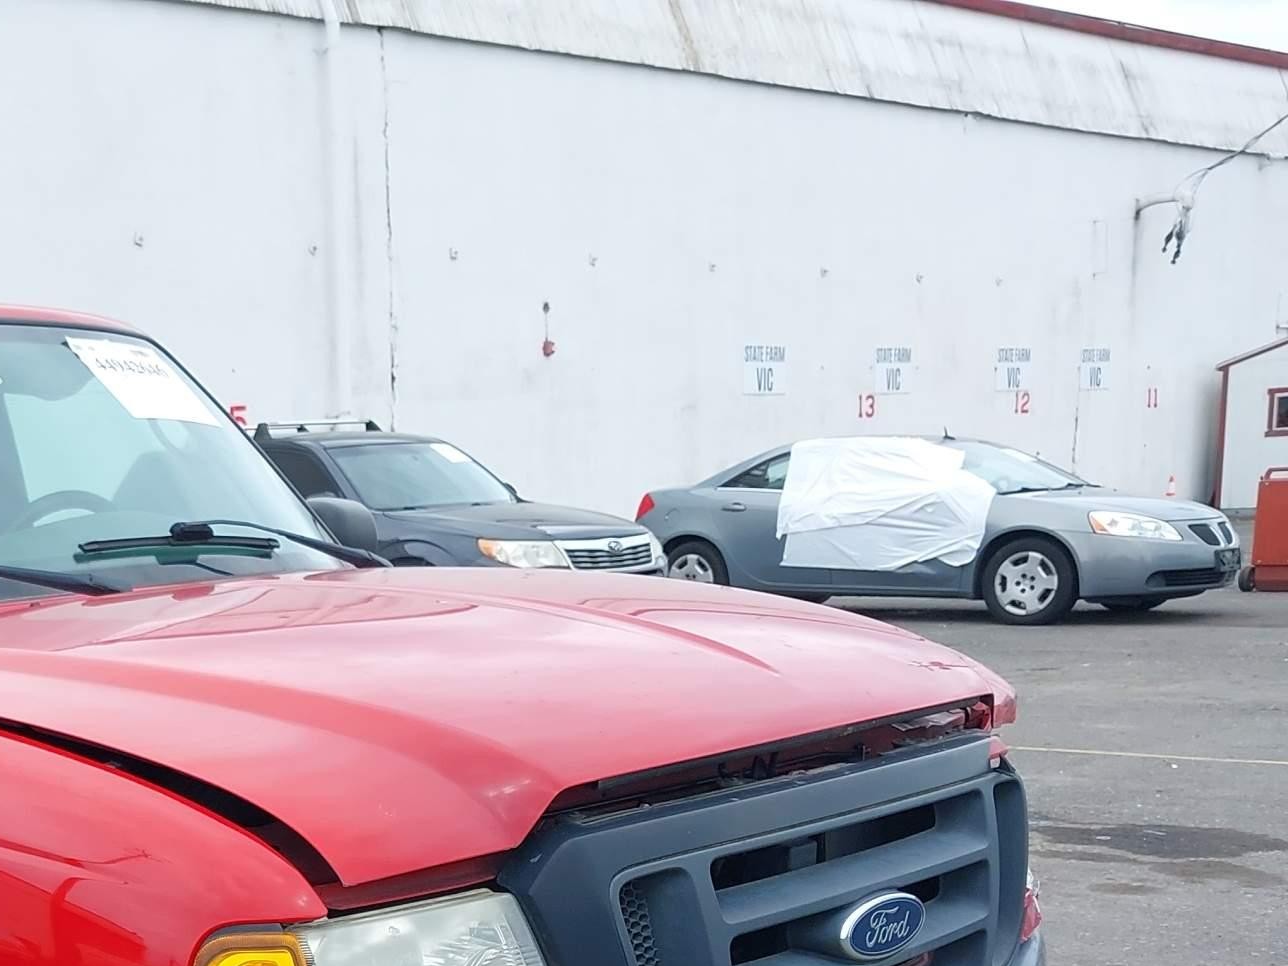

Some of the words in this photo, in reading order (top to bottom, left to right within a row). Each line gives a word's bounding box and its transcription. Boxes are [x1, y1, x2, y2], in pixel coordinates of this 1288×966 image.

[744, 345, 764, 362] STATE
[765, 345, 786, 362] FARM
[876, 348, 893, 363] STATE
[894, 348, 912, 363] FARM
[998, 348, 1014, 363] STATE
[1015, 348, 1031, 363] FARM
[1082, 348, 1095, 363] STATE
[1096, 348, 1111, 363] FARM
[756, 368, 774, 392] VIC
[886, 368, 901, 391] VIC
[1007, 368, 1021, 389] VIC
[1089, 367, 1102, 387] VIC
[858, 395, 876, 418] 13
[1015, 392, 1031, 413] 12
[1147, 388, 1158, 409] 11
[865, 904, 911, 948] Ford
